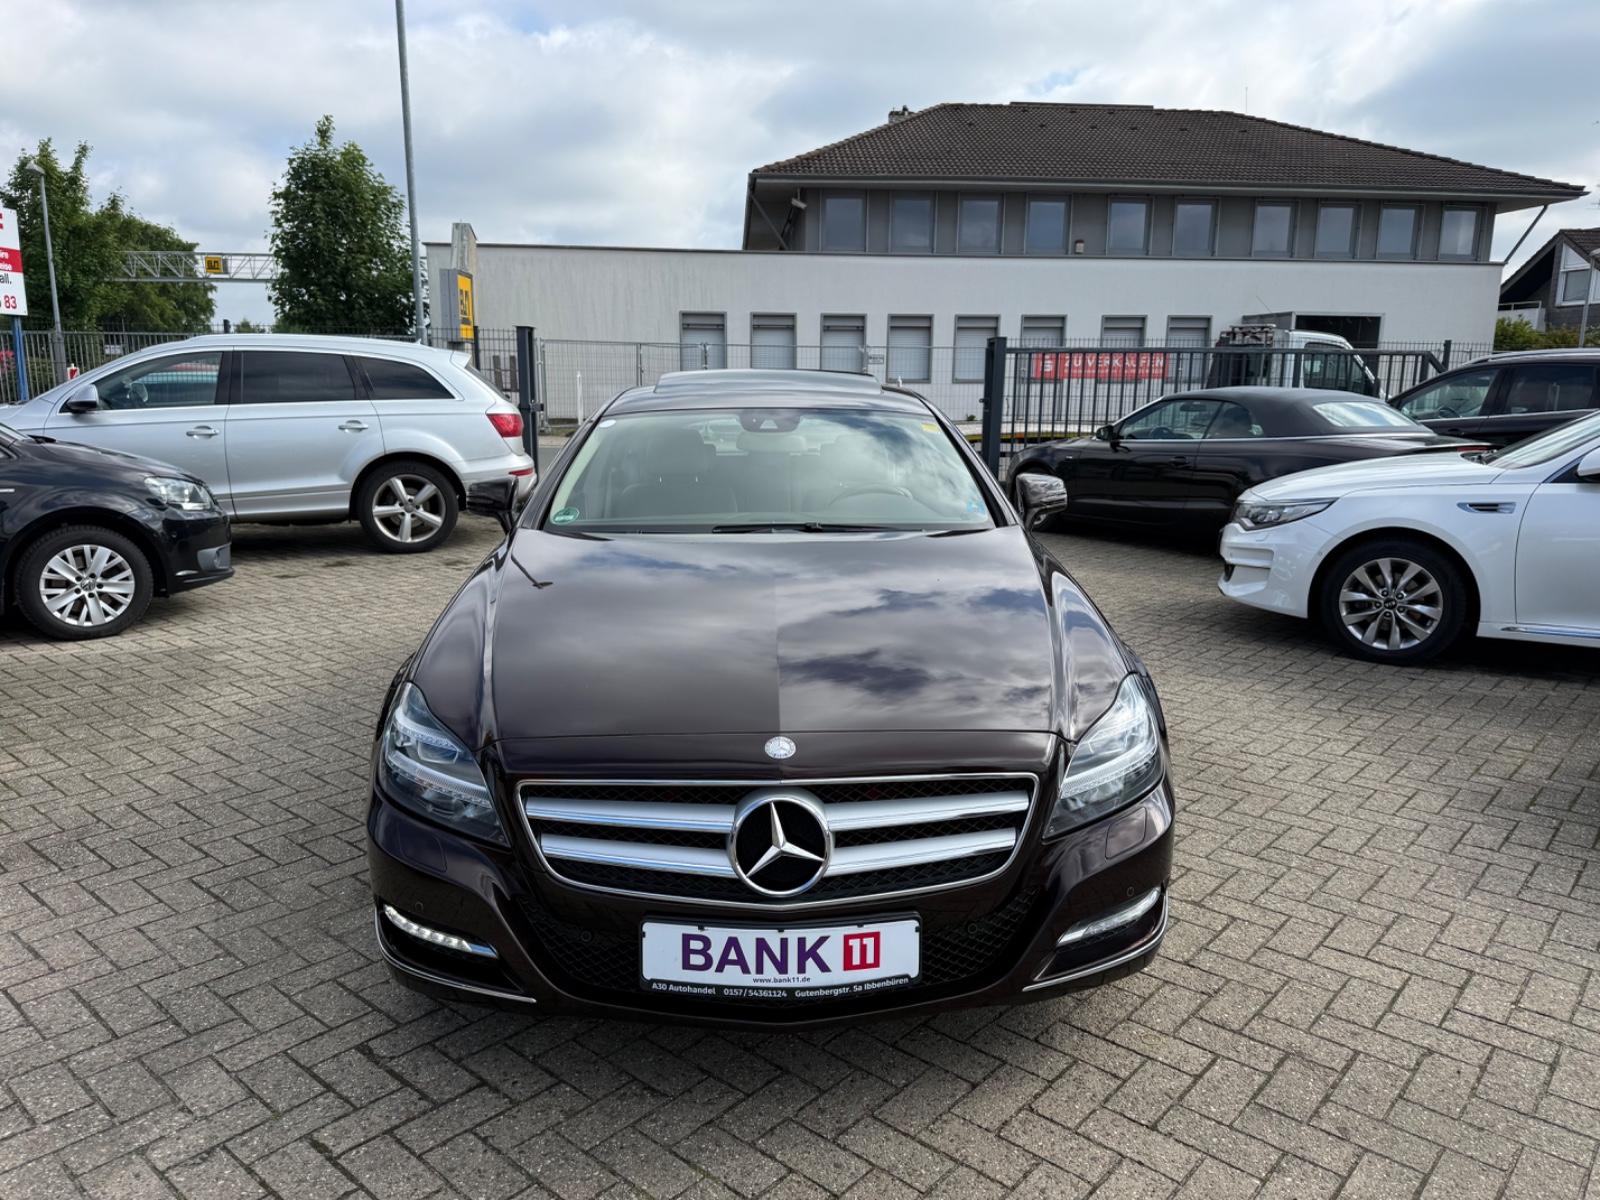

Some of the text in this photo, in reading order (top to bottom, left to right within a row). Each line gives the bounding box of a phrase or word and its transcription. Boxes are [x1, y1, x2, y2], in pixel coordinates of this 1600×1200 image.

[4, 295, 17, 309] 83
[682, 933, 876, 975] BANK 11
[652, 982, 667, 990] A30
[668, 983, 716, 995] Autohandel
[795, 987, 852, 998] Gutenbergstr.
[853, 984, 862, 993] 5a
[864, 977, 909, 990] Ibbenbüren
[752, 976, 811, 984] www.bank11.de
